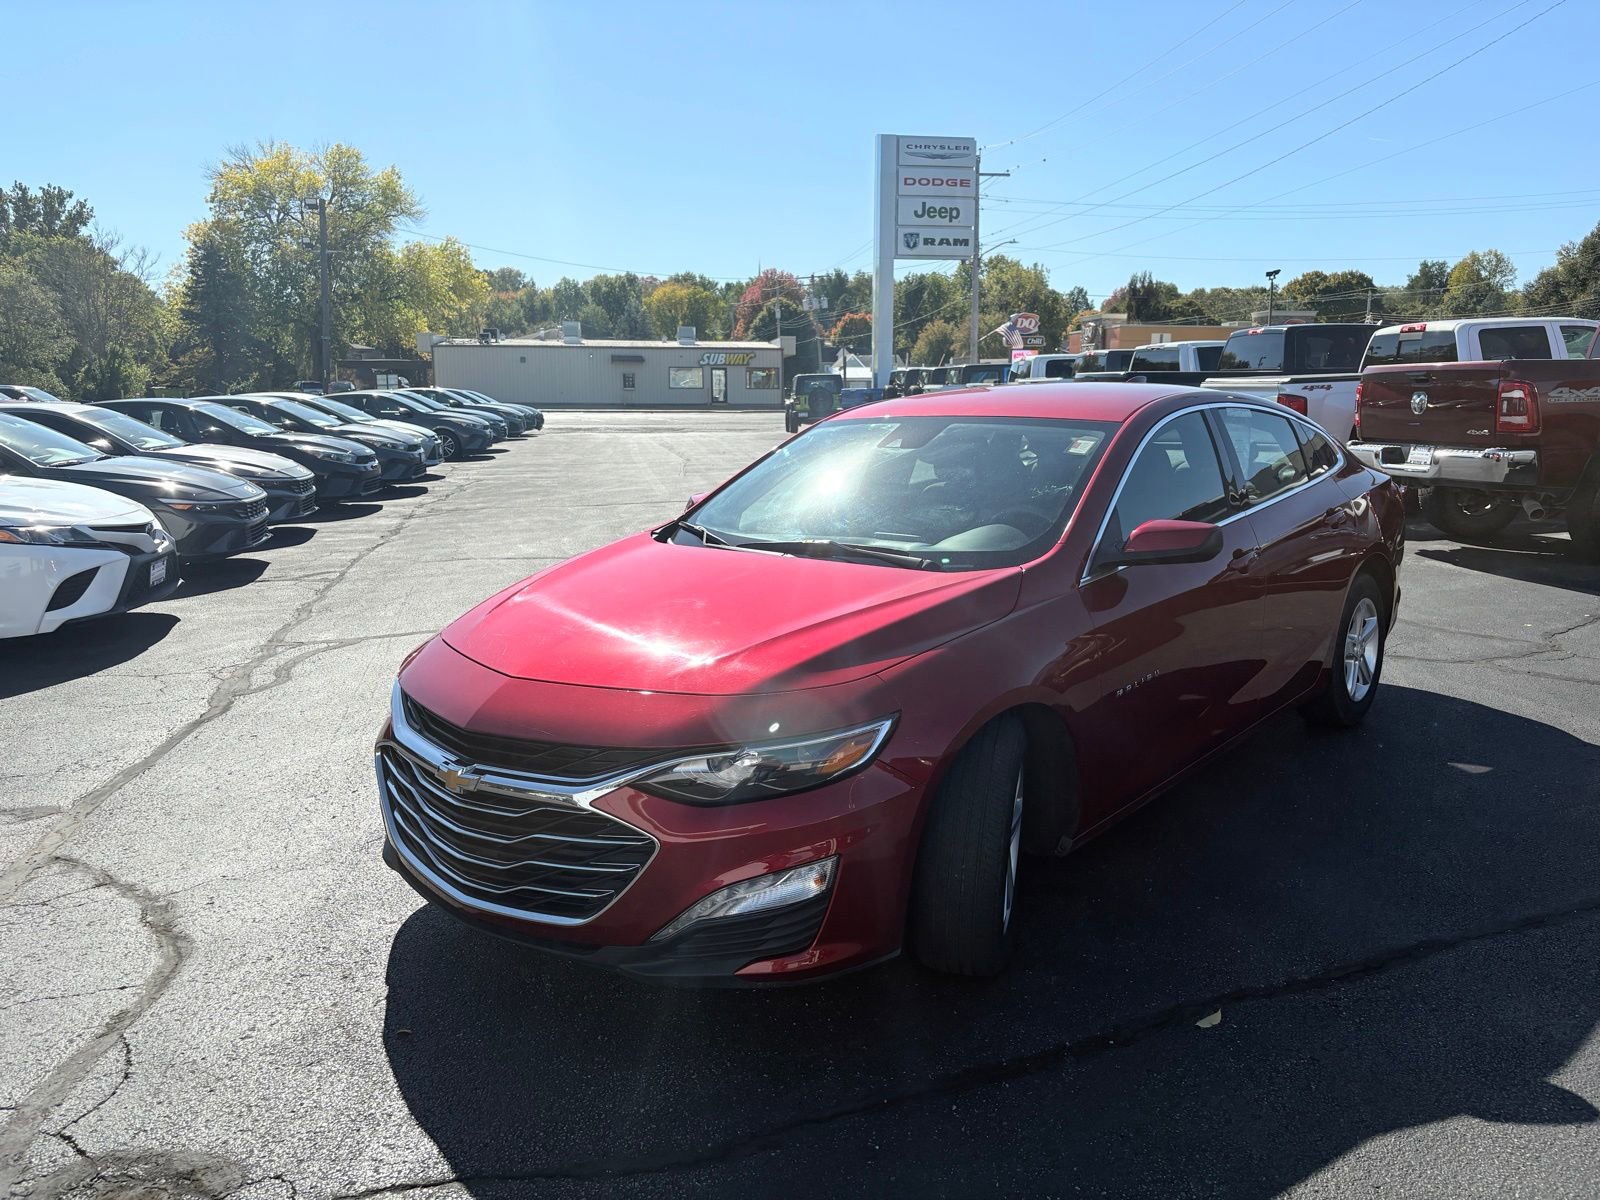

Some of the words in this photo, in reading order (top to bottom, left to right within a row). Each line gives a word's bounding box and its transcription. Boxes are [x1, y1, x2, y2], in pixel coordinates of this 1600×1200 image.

[904, 177, 971, 188] DODGE
[914, 202, 960, 222] Jeep
[923, 237, 970, 247] RAM
[1016, 317, 1036, 330] DQ
[700, 353, 755, 365] SUBWAY
